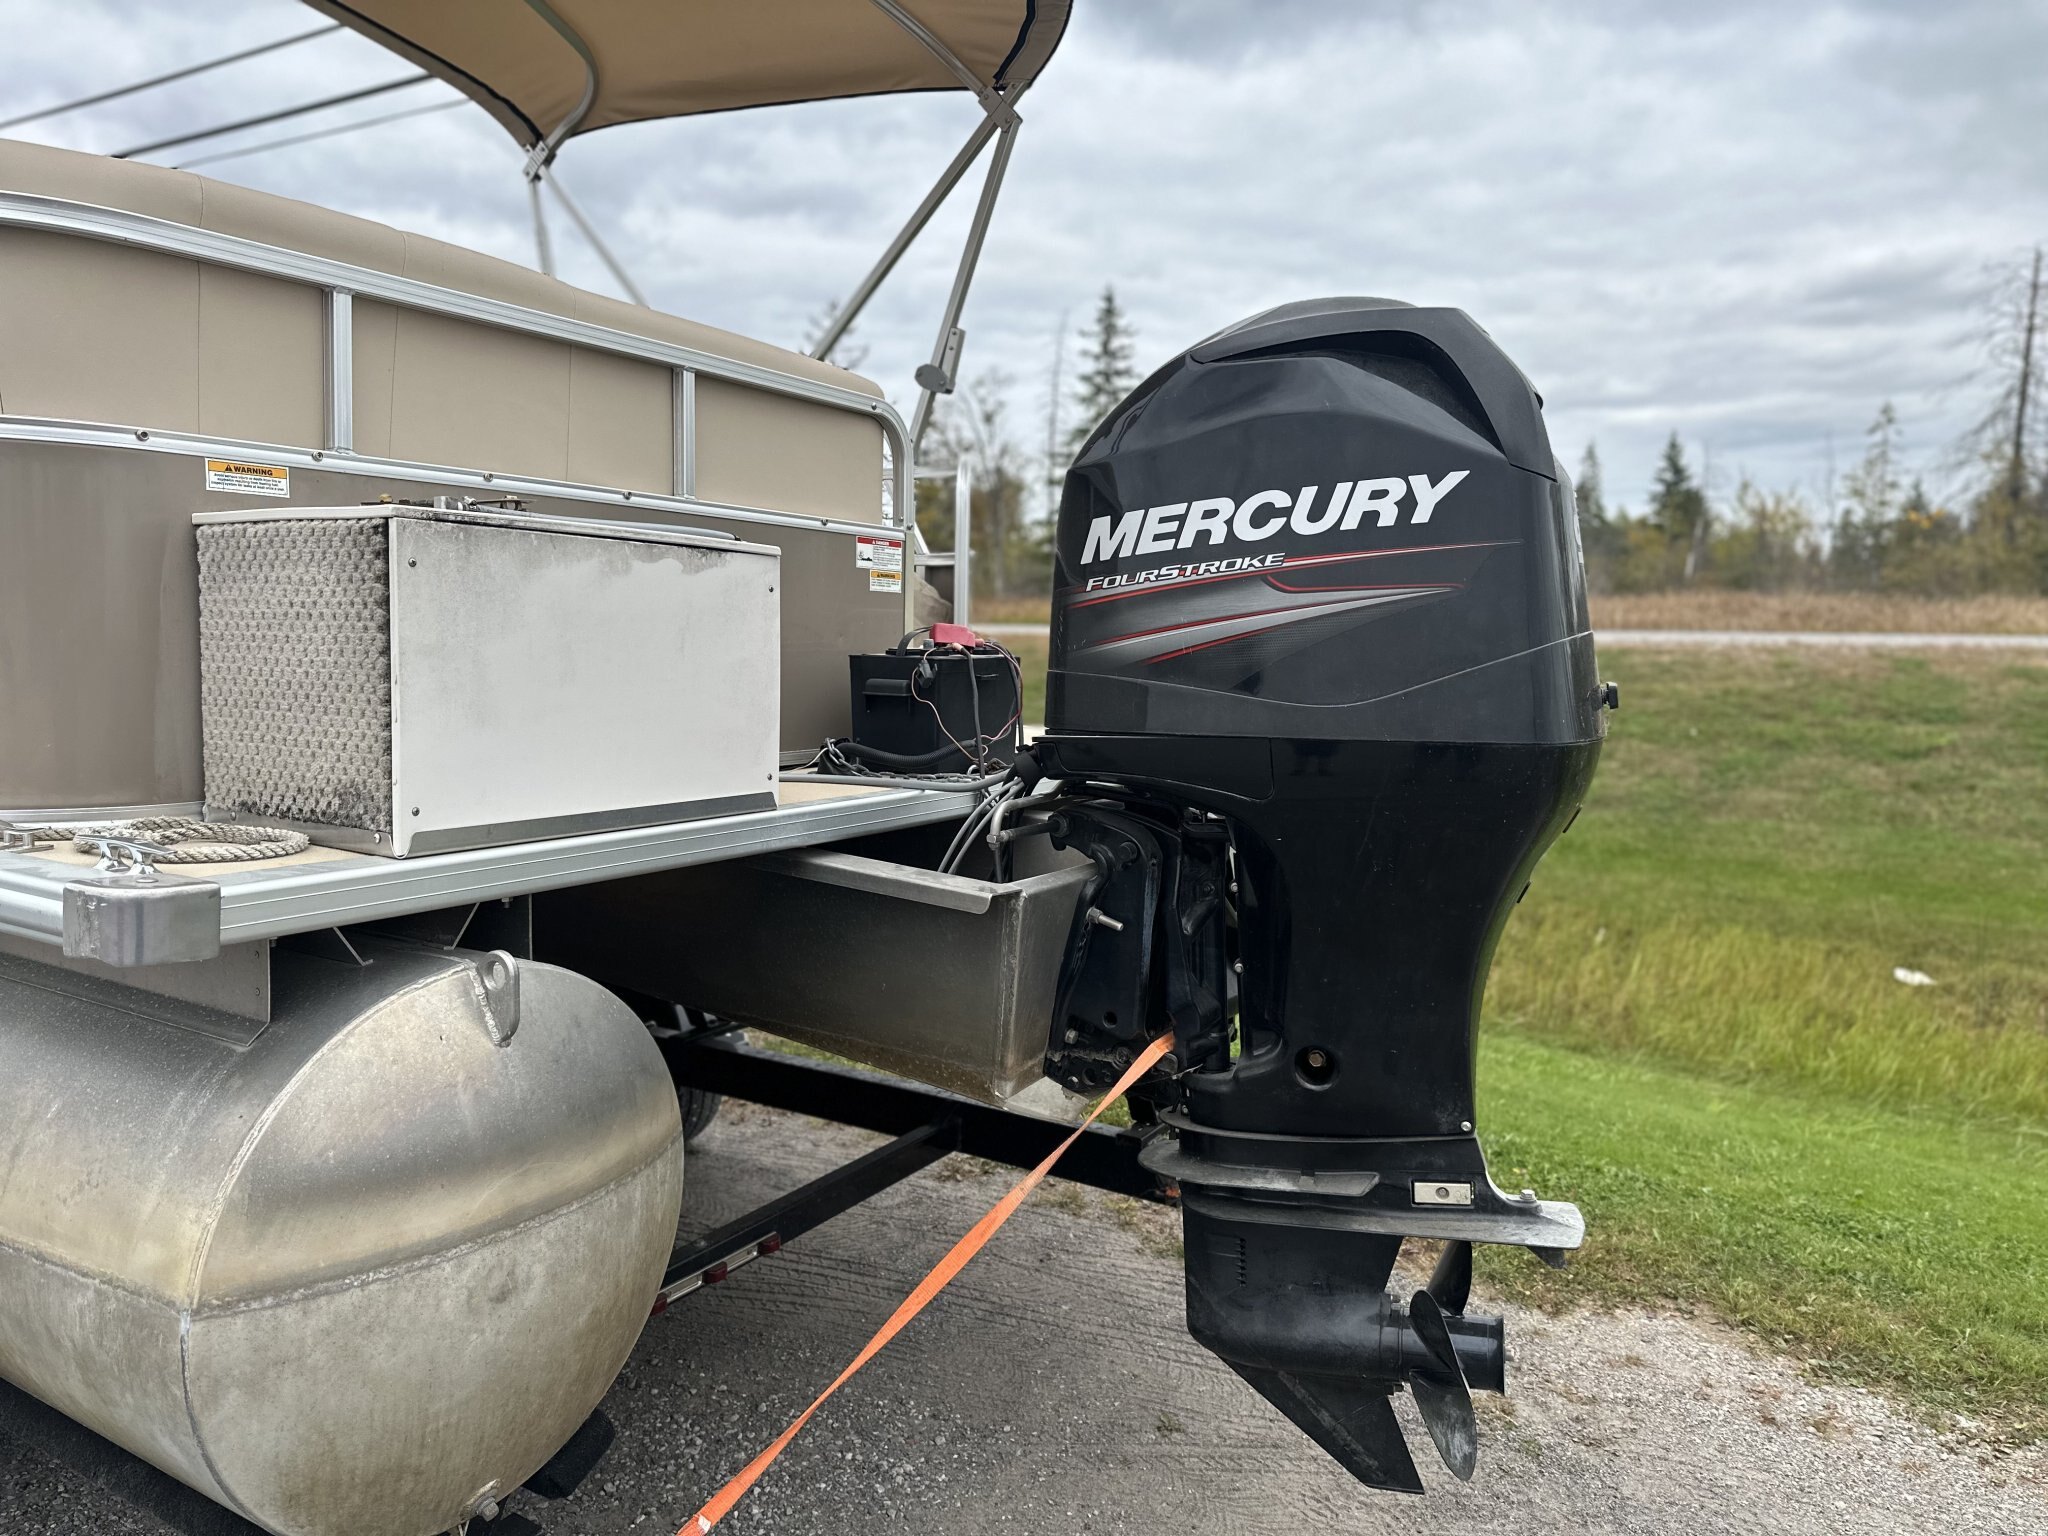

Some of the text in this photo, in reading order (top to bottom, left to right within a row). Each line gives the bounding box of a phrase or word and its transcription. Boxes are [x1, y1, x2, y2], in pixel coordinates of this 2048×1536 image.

[233, 465, 273, 476] WARNING
[1080, 470, 1471, 565] MERCURY
[1086, 552, 1287, 592] FOURSTROKE
